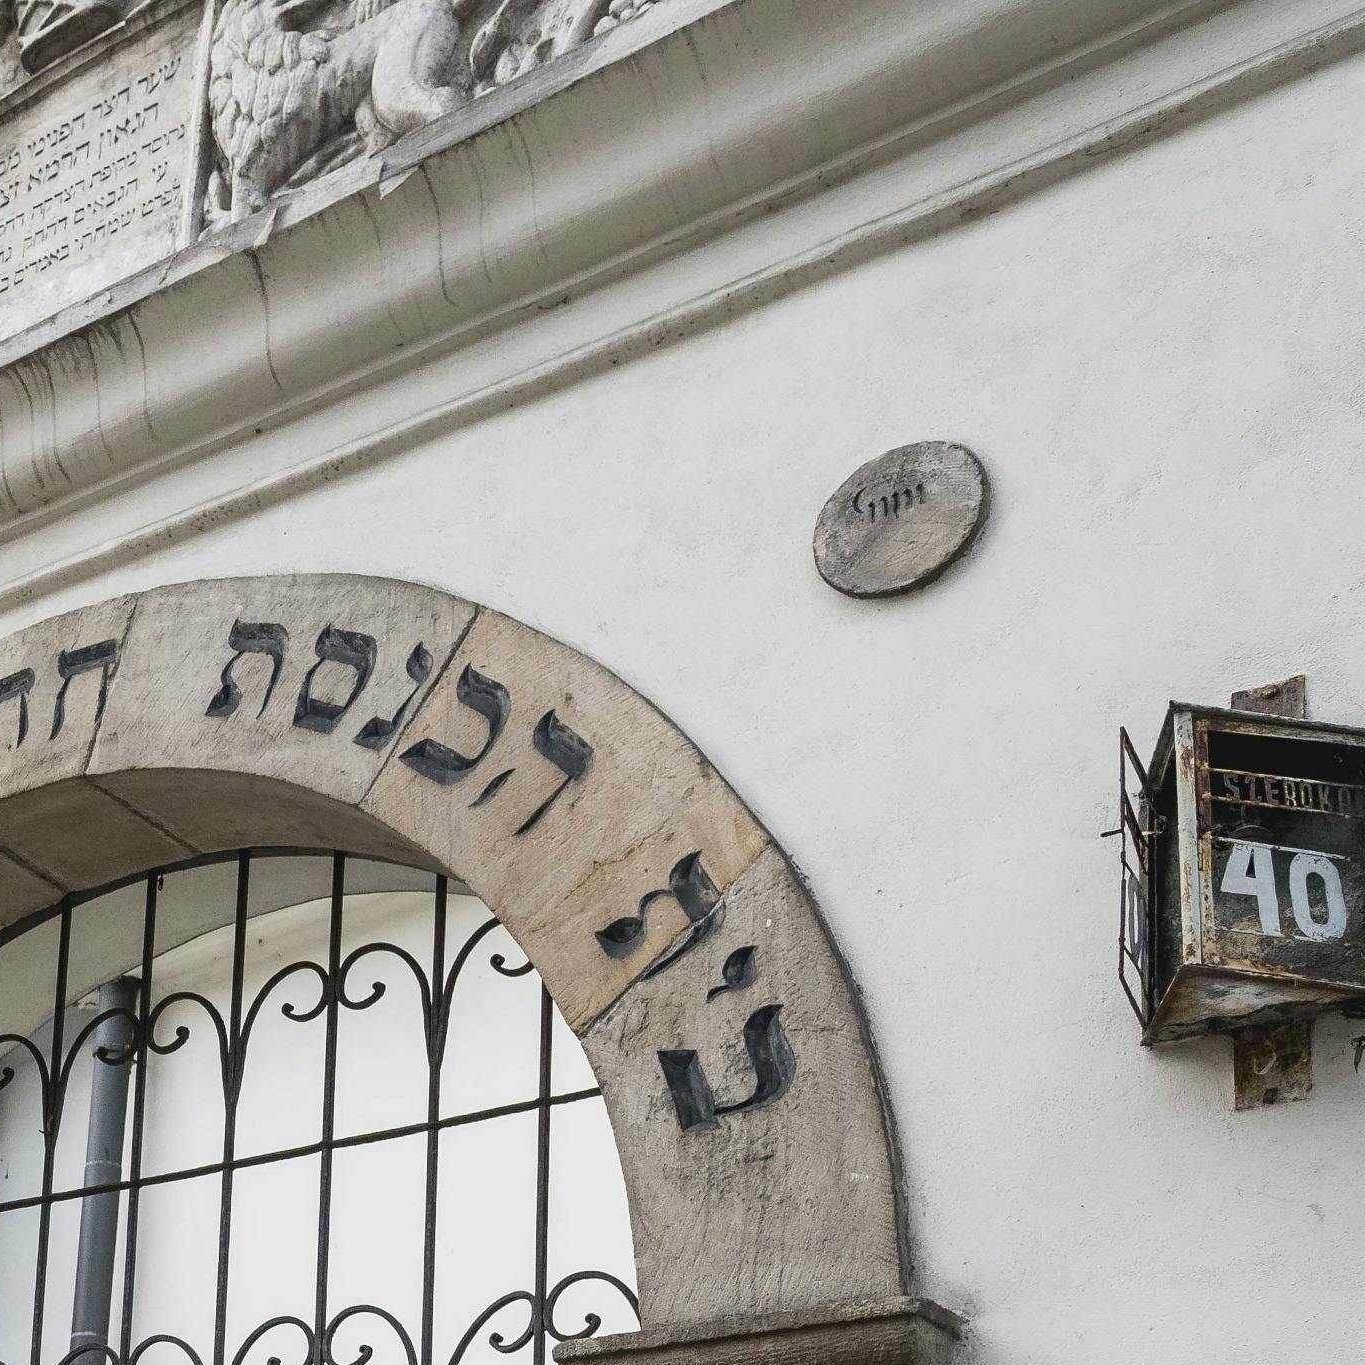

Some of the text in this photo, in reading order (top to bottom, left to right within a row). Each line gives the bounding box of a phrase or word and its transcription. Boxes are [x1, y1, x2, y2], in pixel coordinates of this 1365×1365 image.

[205, 618, 595, 836] הכנסת
[595, 850, 798, 1133] בית
[1221, 842, 1347, 942] 40
